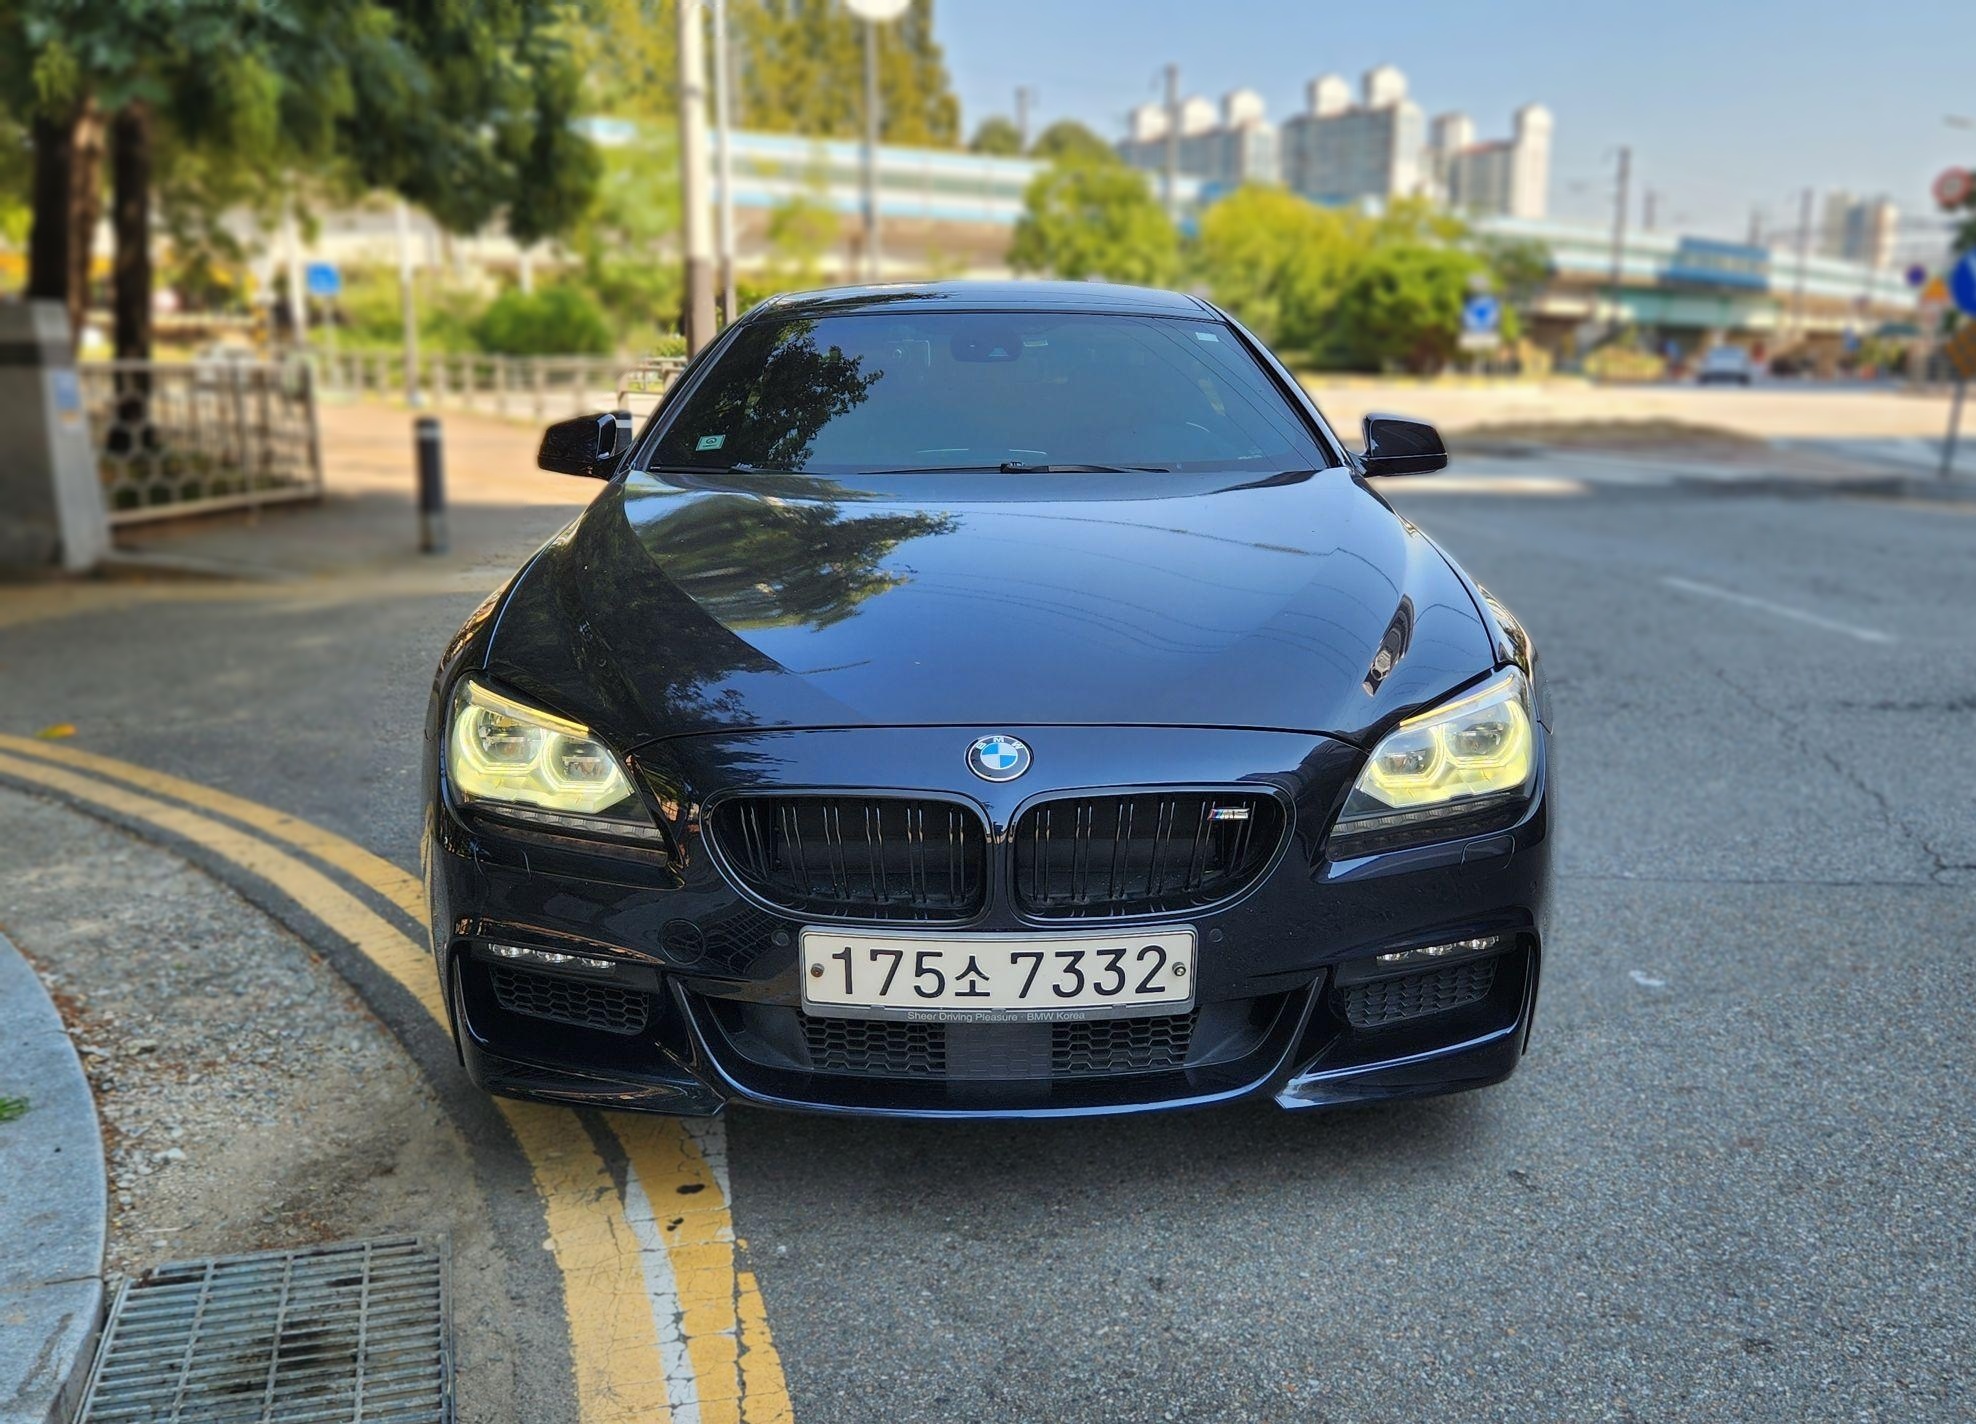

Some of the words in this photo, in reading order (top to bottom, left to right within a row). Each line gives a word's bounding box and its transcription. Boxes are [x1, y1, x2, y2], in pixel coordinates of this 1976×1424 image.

[975, 736, 1024, 750] BMW
[831, 946, 991, 999] 175소
[1010, 944, 1167, 999] 7332
[907, 1011, 937, 1021] Sheer
[939, 1012, 973, 1023] Driving
[975, 1013, 1018, 1022] Pleasure
[1027, 1013, 1054, 1021] BMW
[1056, 1011, 1085, 1020] Korea
